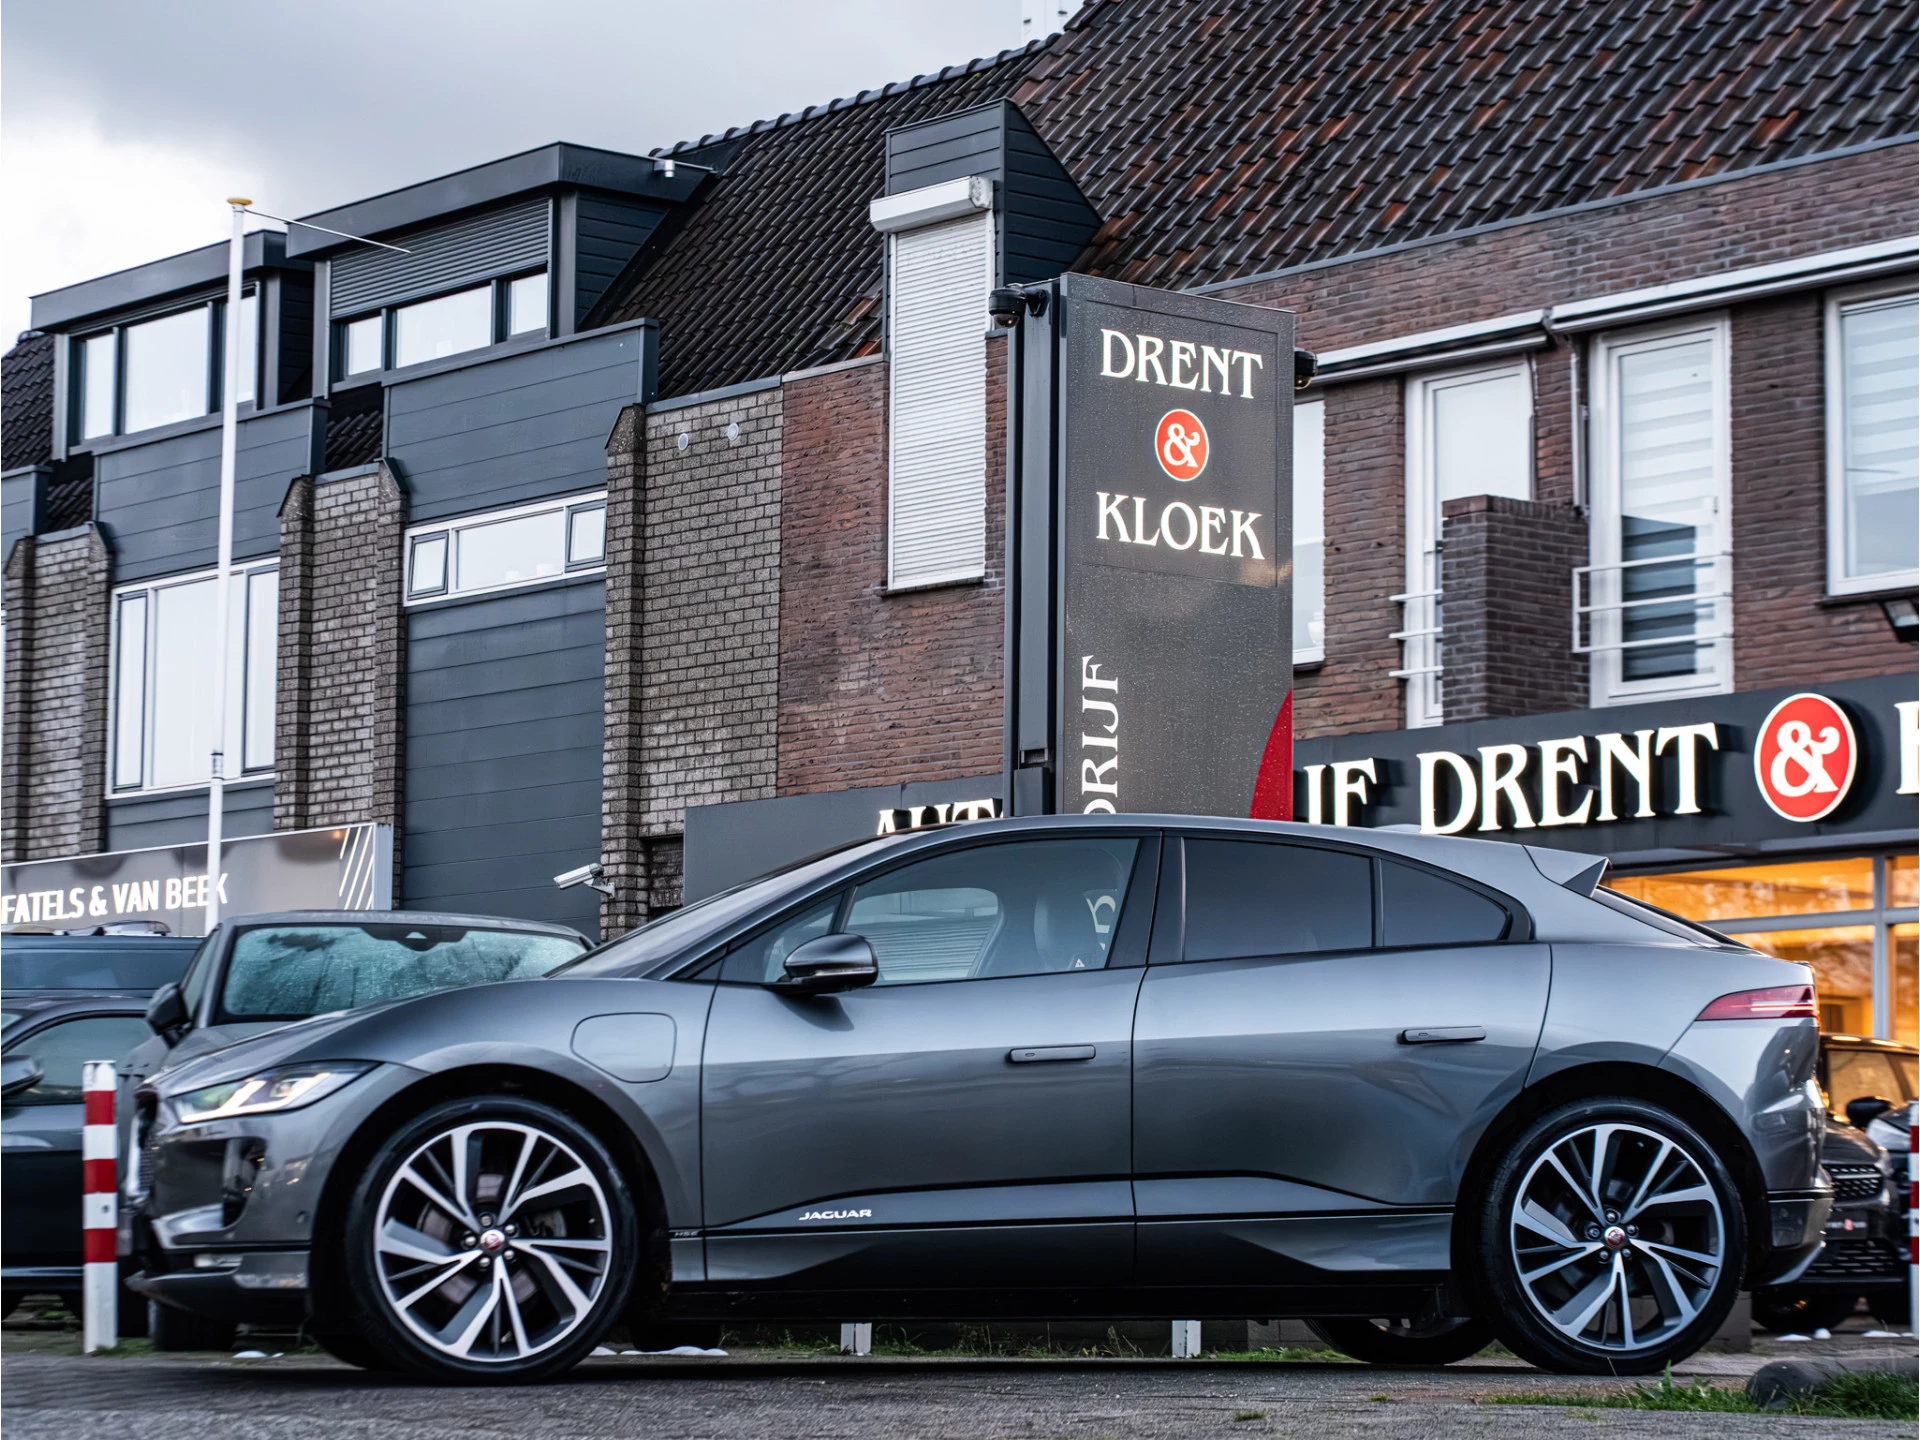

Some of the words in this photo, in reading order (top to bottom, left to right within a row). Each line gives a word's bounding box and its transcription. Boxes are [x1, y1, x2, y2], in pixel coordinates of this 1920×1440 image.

[1100, 329, 1263, 399] DRENT
[1164, 423, 1201, 468] &
[1096, 492, 1265, 560] KLOEK
[1416, 722, 1719, 835] DRENT
[1771, 720, 1840, 797] &
[89, 886, 107, 916] &
[112, 880, 160, 914] VAN
[799, 1209, 872, 1221] JAGUAR
